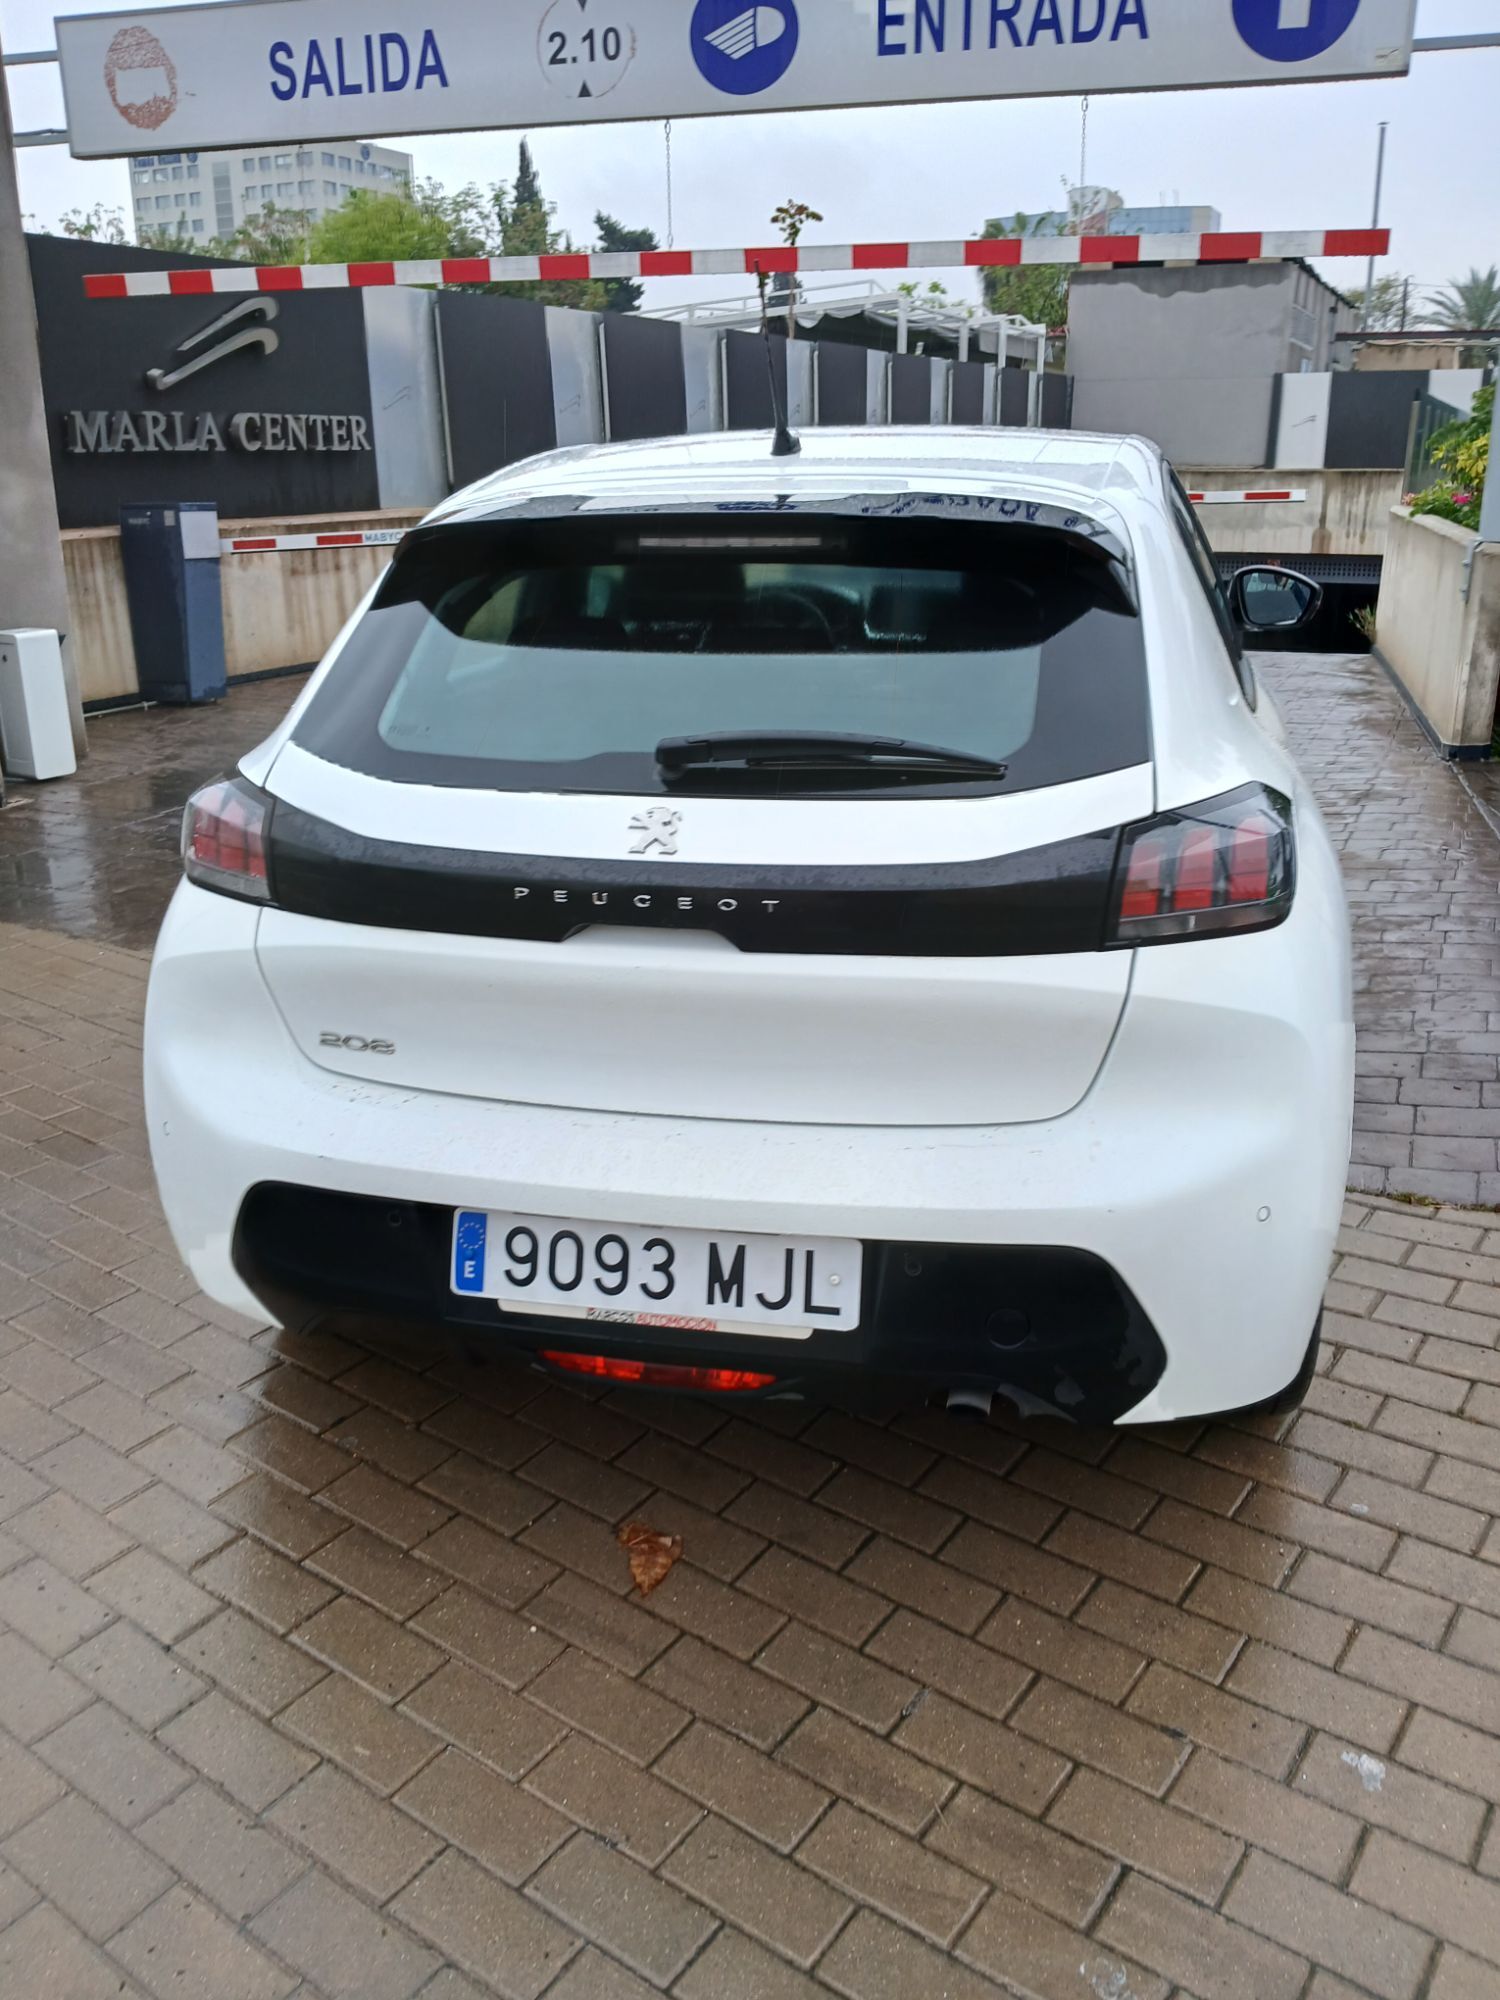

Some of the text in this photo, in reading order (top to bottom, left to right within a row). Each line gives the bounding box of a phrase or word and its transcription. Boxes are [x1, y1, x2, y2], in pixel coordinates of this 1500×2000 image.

[548, 26, 621, 65] 2.10
[877, 0, 1149, 56] ENTRADA
[269, 29, 449, 101] SALIDA
[68, 409, 372, 453] MARLA CENTER
[513, 886, 780, 913] PEUGEOT
[464, 1260, 476, 1279] E
[504, 1226, 841, 1316] 9093 MJL
